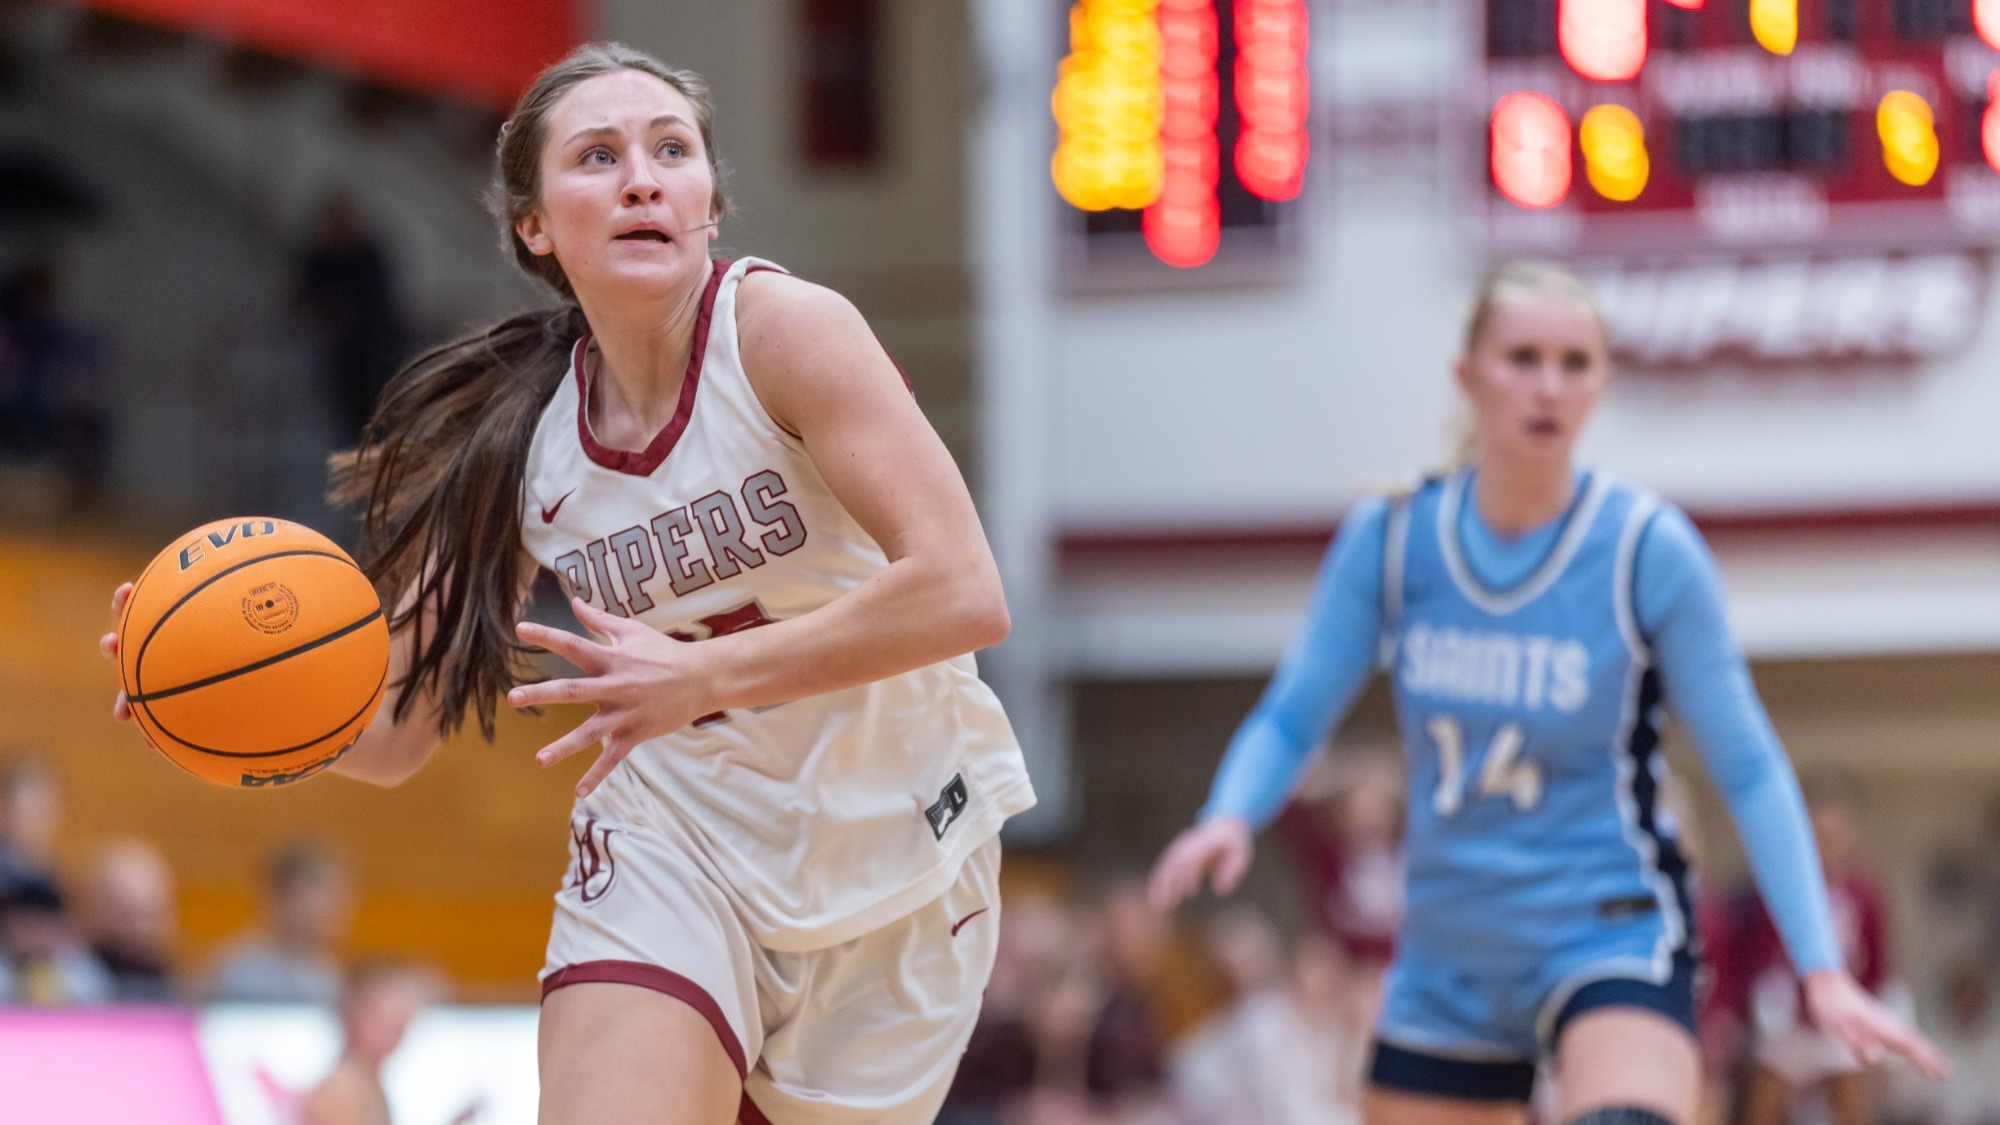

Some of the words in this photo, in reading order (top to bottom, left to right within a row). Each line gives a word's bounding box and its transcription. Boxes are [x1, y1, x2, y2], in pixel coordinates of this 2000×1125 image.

[177, 519, 276, 572] EVO
[554, 469, 808, 618] PIPERS
[1404, 622, 1589, 714] SAINTS
[1427, 713, 1544, 817] 14
